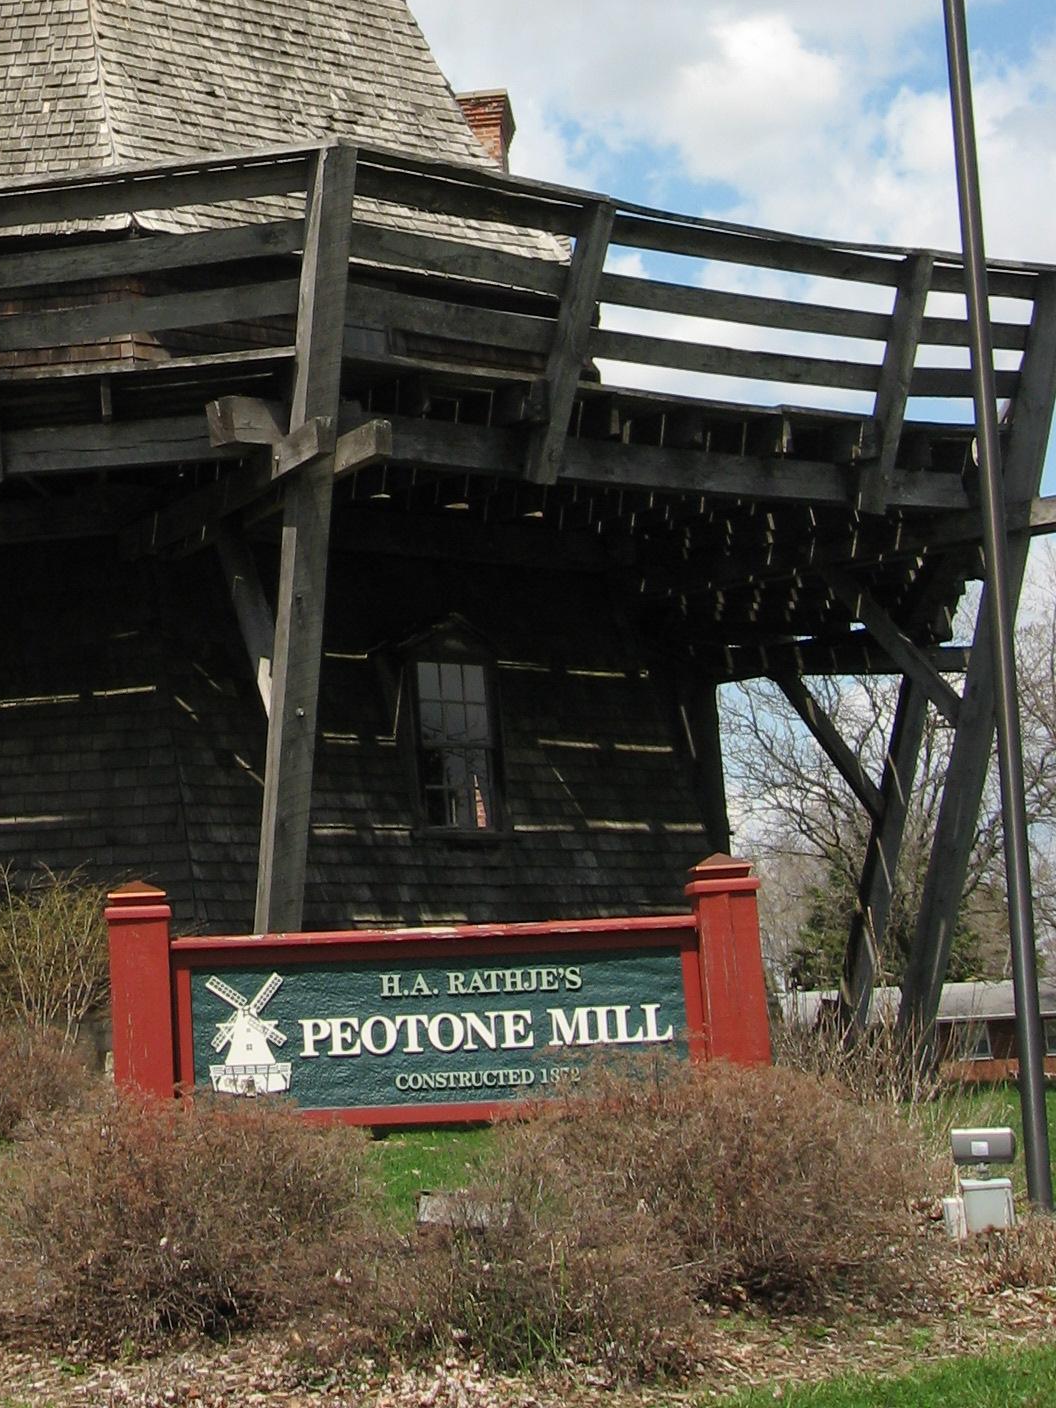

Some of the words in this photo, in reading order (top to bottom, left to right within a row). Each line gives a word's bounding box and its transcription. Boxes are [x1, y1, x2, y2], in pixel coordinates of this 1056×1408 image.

[379, 972, 440, 998] H.A.
[446, 966, 583, 995] RATHJE'S
[298, 1009, 535, 1058] PEOTONE
[546, 1002, 675, 1047] MILL
[395, 1068, 536, 1091] CONSTRUCTED
